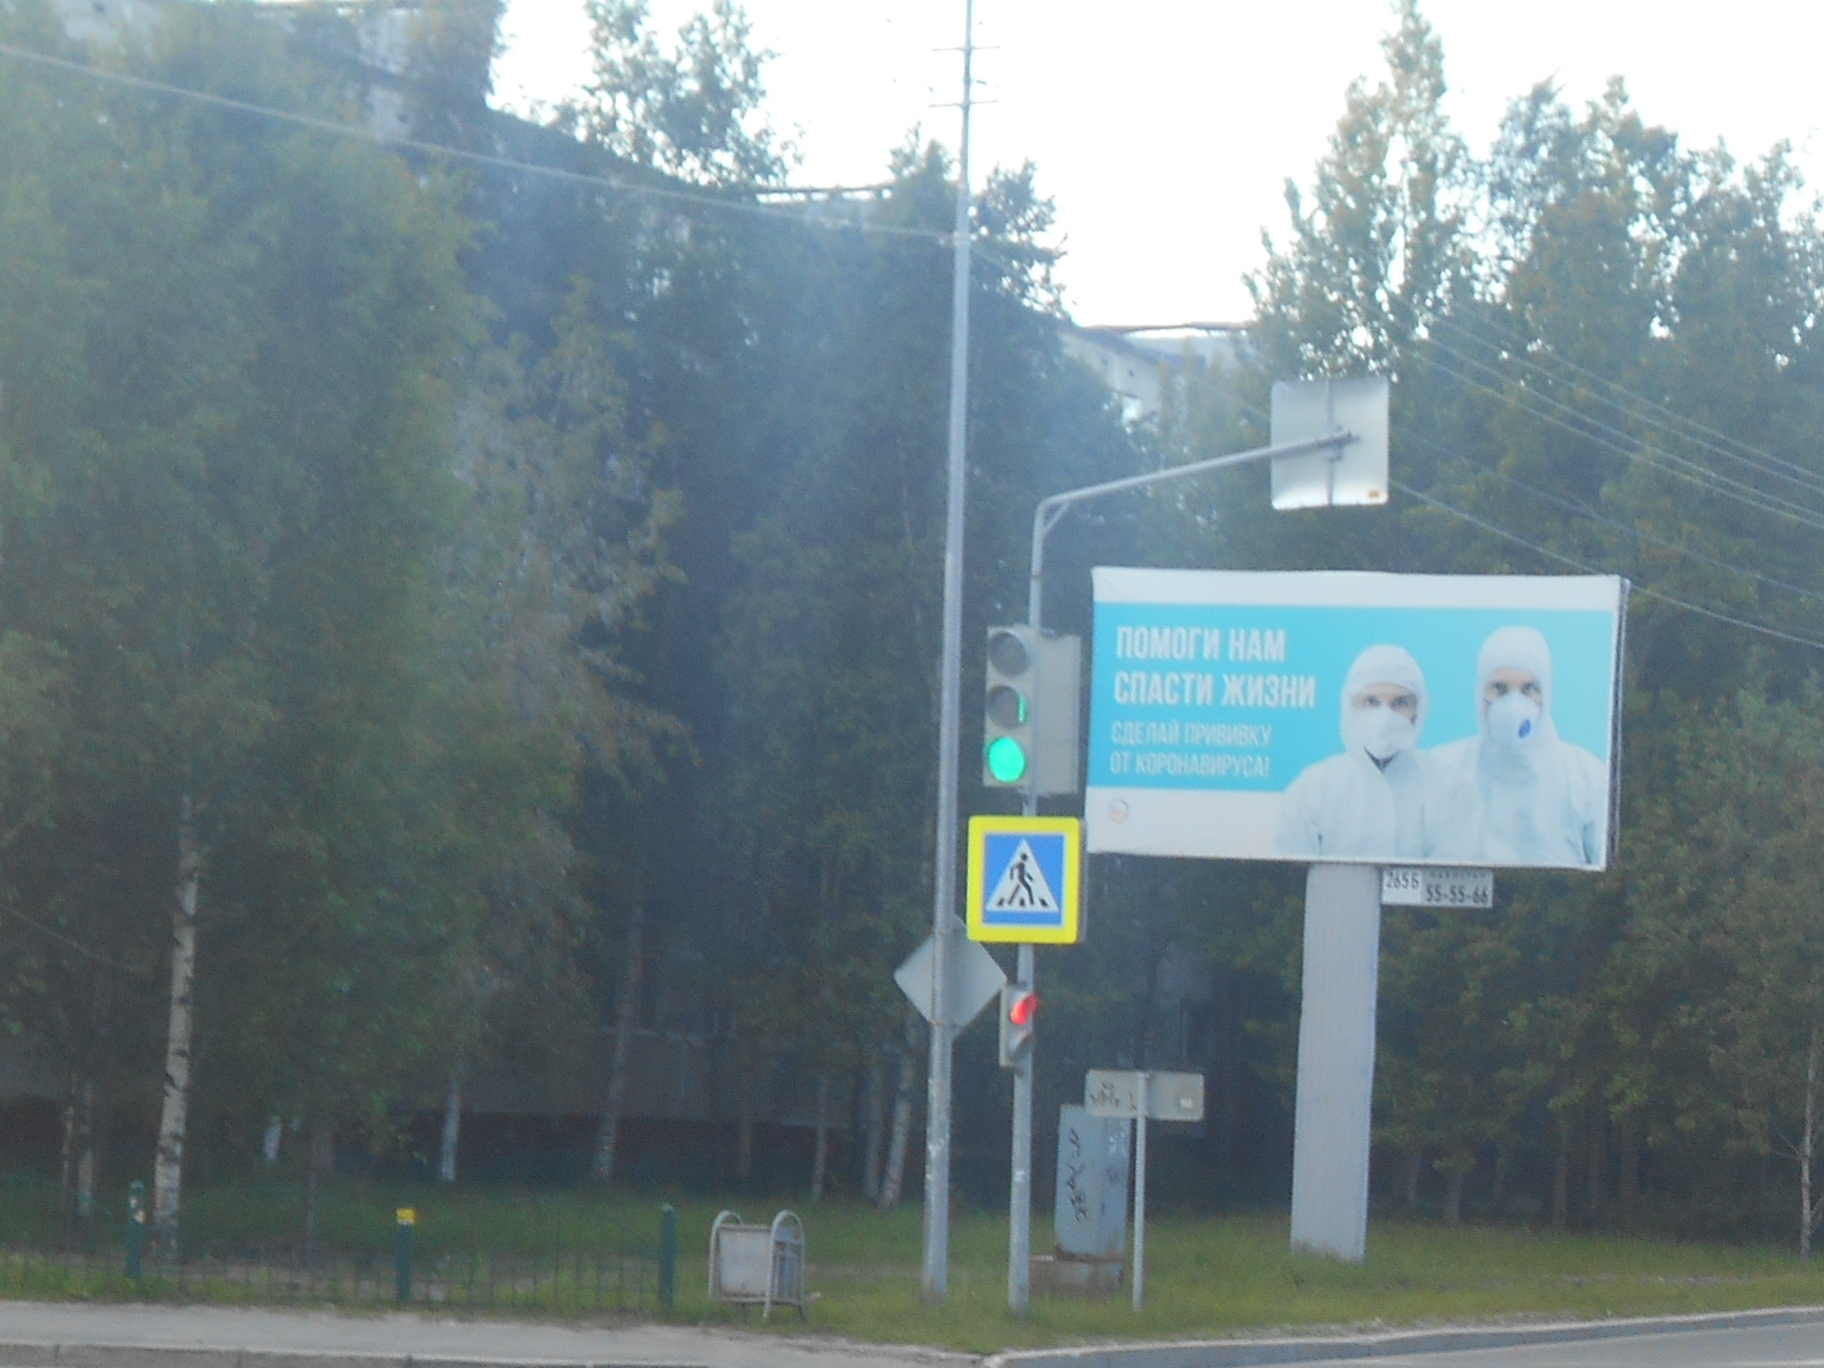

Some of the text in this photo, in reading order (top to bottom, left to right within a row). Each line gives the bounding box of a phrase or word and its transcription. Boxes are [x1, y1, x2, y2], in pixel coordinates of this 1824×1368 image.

[1117, 626, 1286, 662] ПОМОГИ НАМ
[1115, 671, 1316, 708] СПАСТИ ЖИЗНИ
[1111, 719, 1273, 748] СДЕЛАЙ ПРИВИВКУ
[1110, 751, 1270, 778] ОТ КОРОНАВИРУСА!
[1425, 884, 1489, 904] 55-55-66
